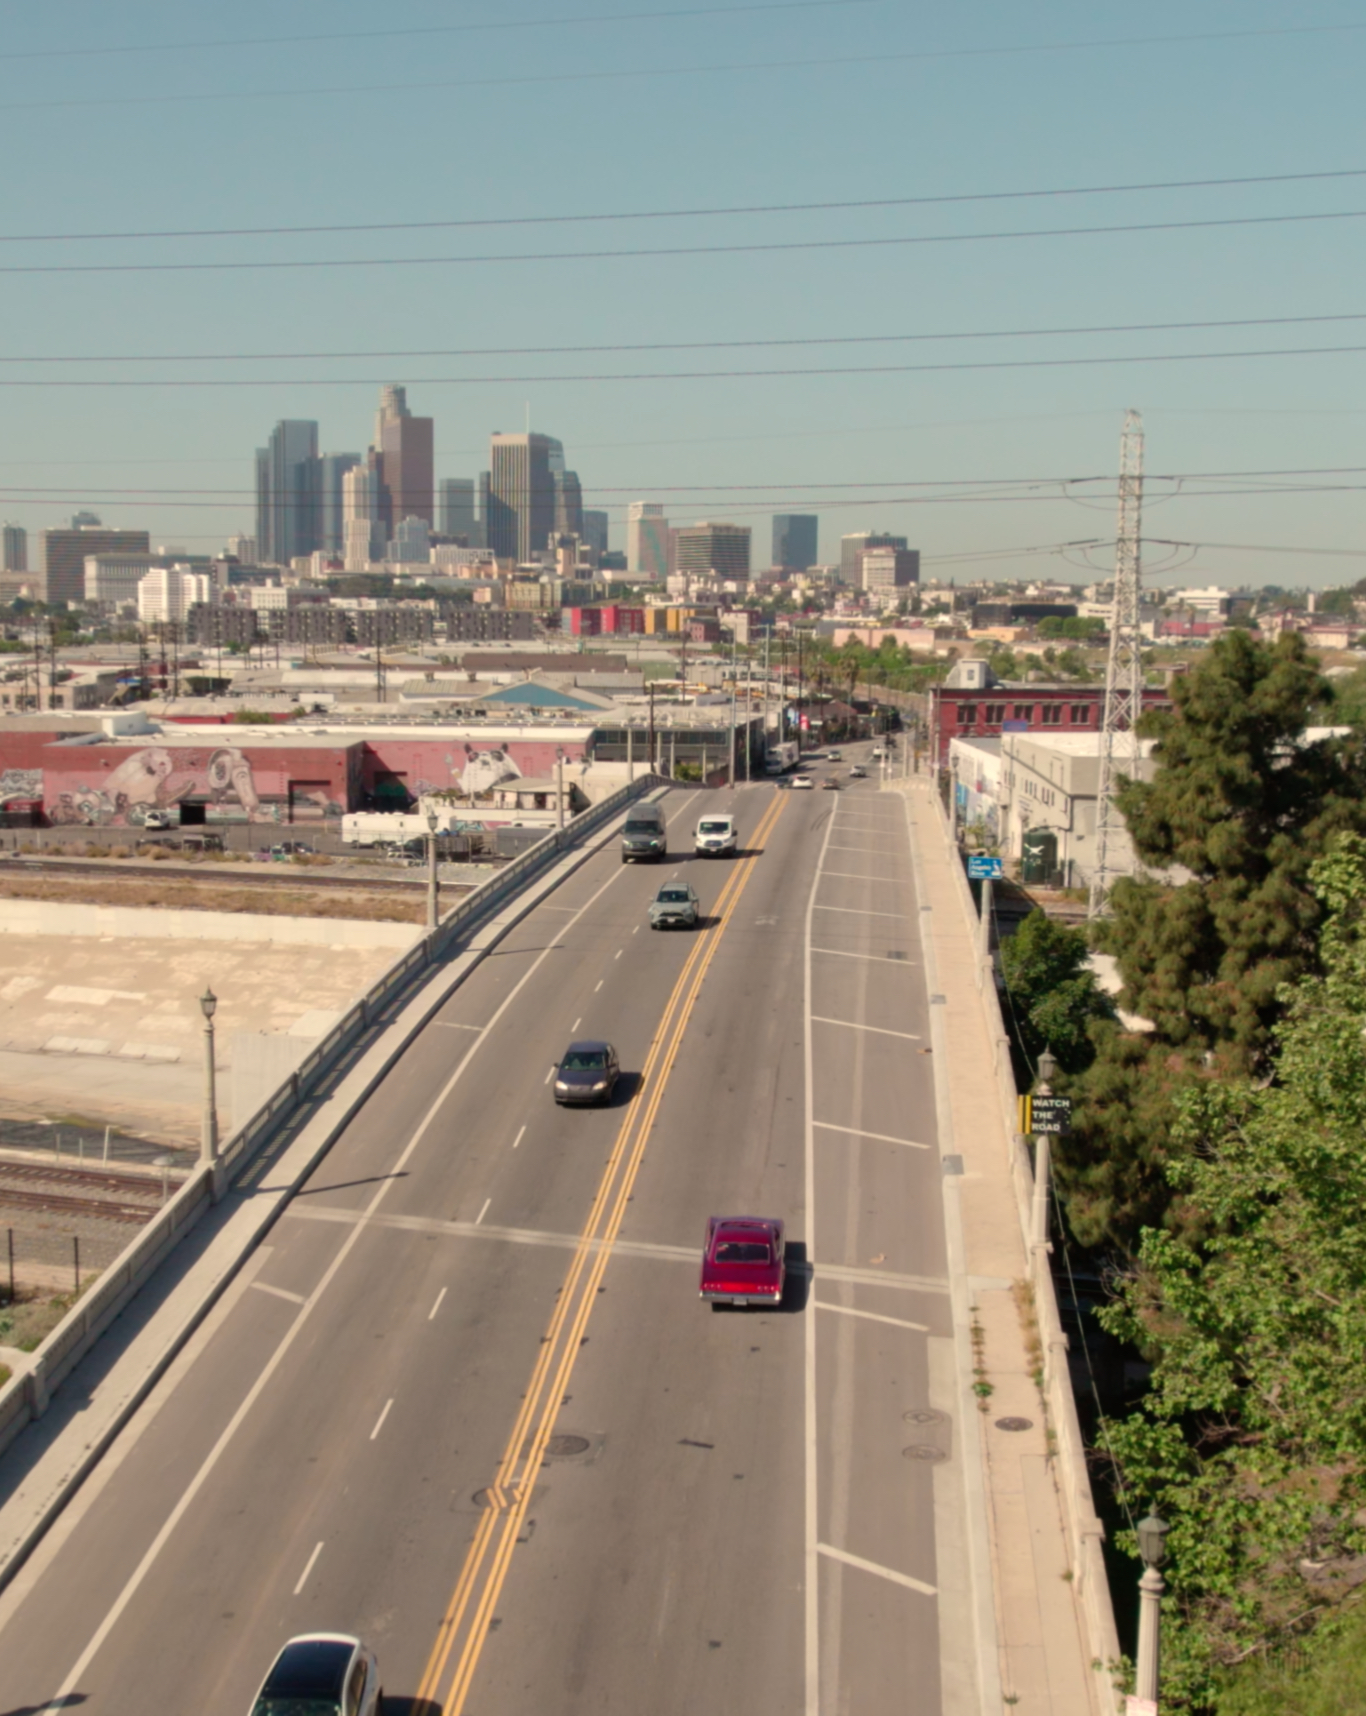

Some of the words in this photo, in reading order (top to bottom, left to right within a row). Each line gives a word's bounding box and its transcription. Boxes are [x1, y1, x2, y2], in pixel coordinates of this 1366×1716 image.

[1032, 1099, 1070, 1108] WATCH
[1032, 1111, 1053, 1119] THE
[1032, 1123, 1061, 1131] ROAD
